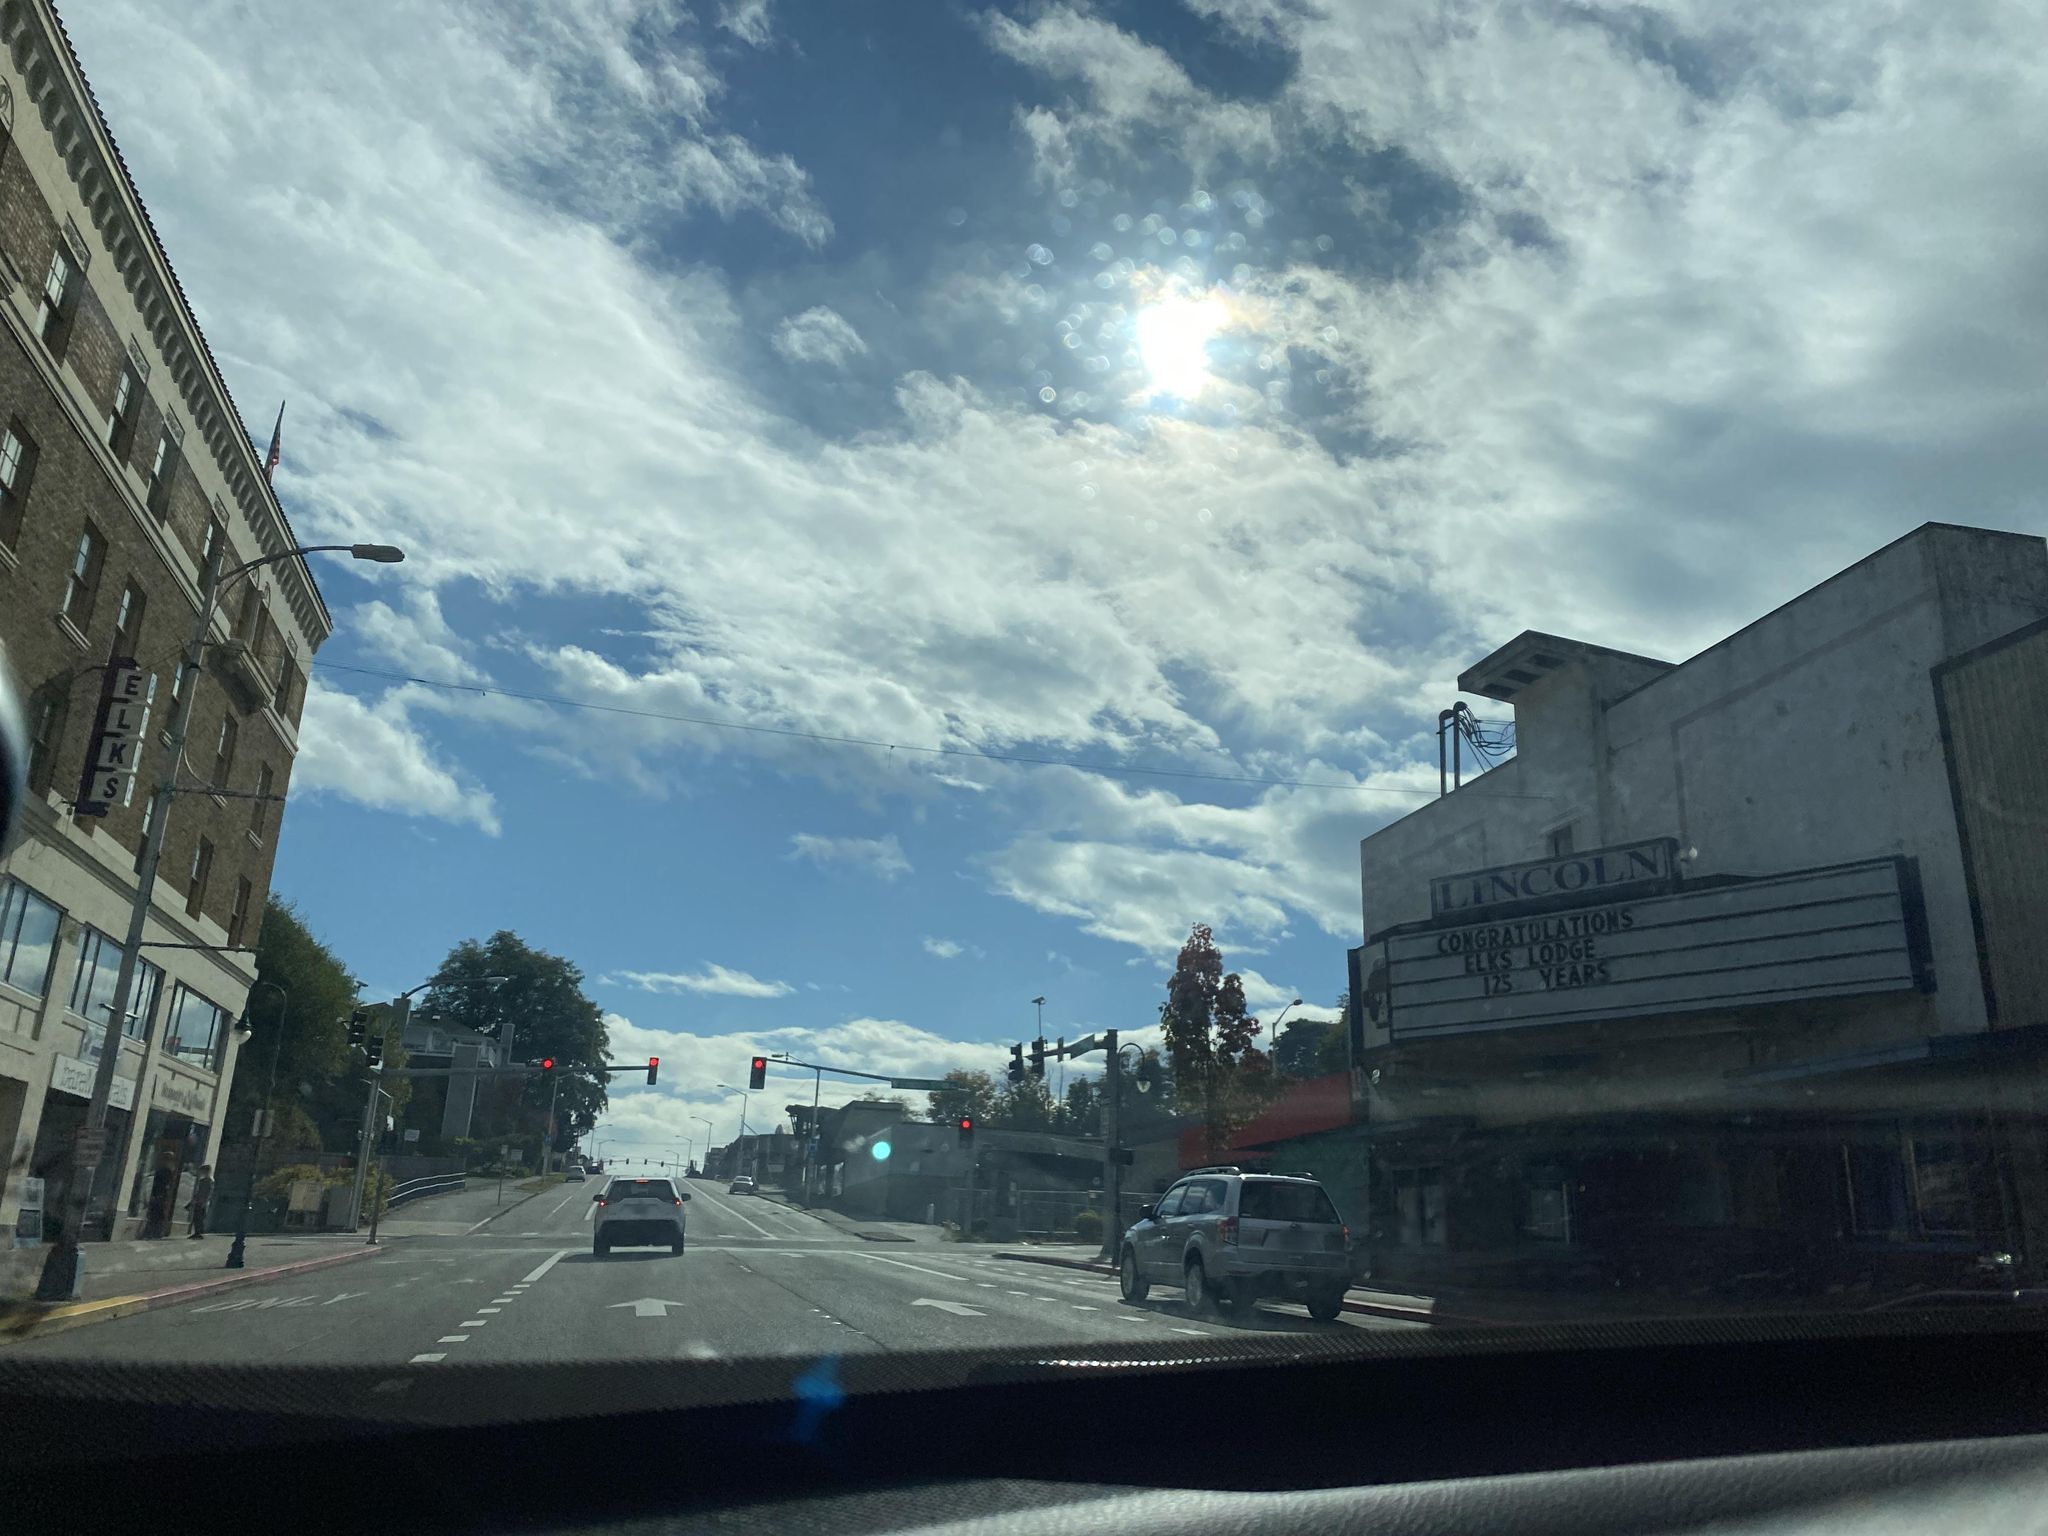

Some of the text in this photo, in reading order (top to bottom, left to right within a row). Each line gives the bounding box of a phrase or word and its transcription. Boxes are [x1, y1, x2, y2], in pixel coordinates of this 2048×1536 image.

[103, 675, 142, 799] ELKS
[1440, 846, 1660, 911] LINCOLN
[1437, 909, 1635, 955] CONGRATULATIONS
[1464, 938, 1597, 974] ELKS LODGE
[1539, 962, 1610, 992] YEARS
